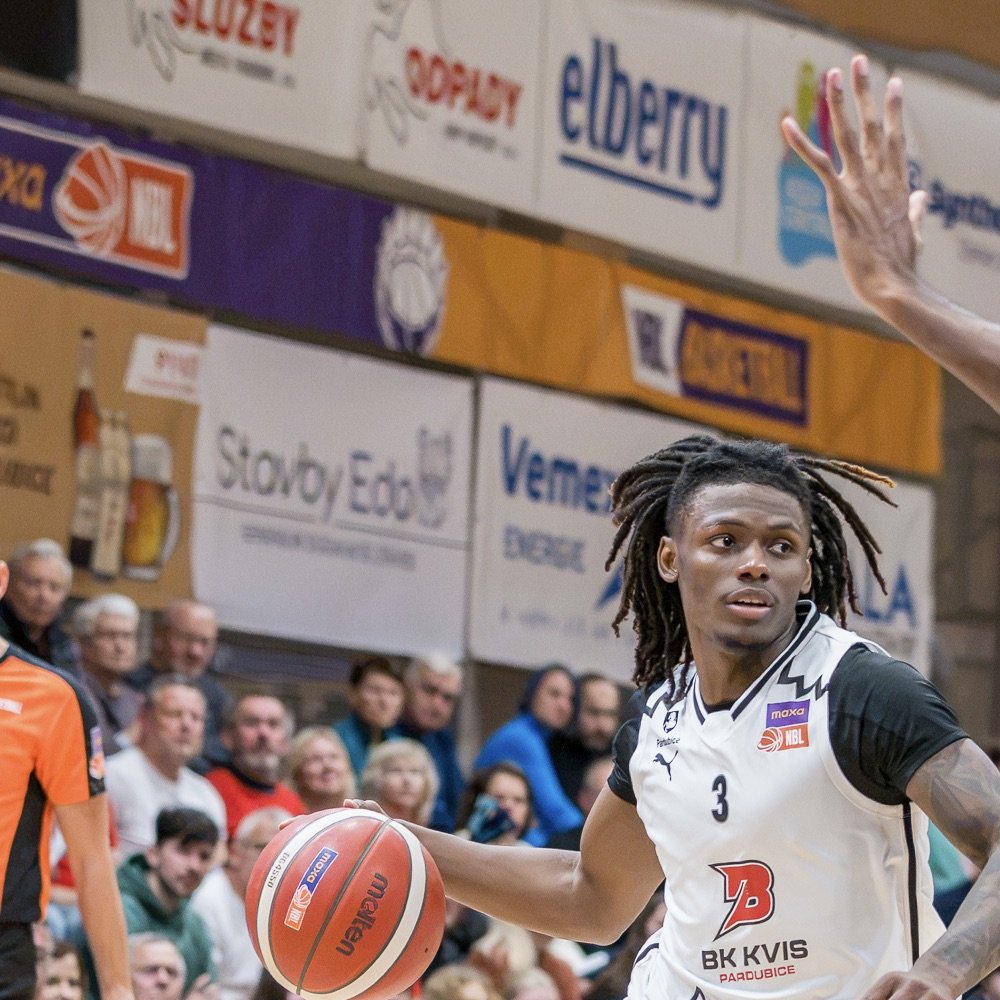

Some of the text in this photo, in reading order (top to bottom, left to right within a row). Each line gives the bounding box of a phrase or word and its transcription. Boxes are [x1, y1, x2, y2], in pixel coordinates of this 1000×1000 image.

[559, 33, 730, 209] elberry
[0, 156, 47, 210] xa
[771, 706, 805, 720] maxa
[785, 728, 804, 746] NBL
[711, 773, 729, 823] 3
[306, 852, 332, 884] maxa
[335, 872, 389, 956] molten
[701, 939, 809, 970] BK KVIS
[719, 964, 796, 984] PARDUBICE
